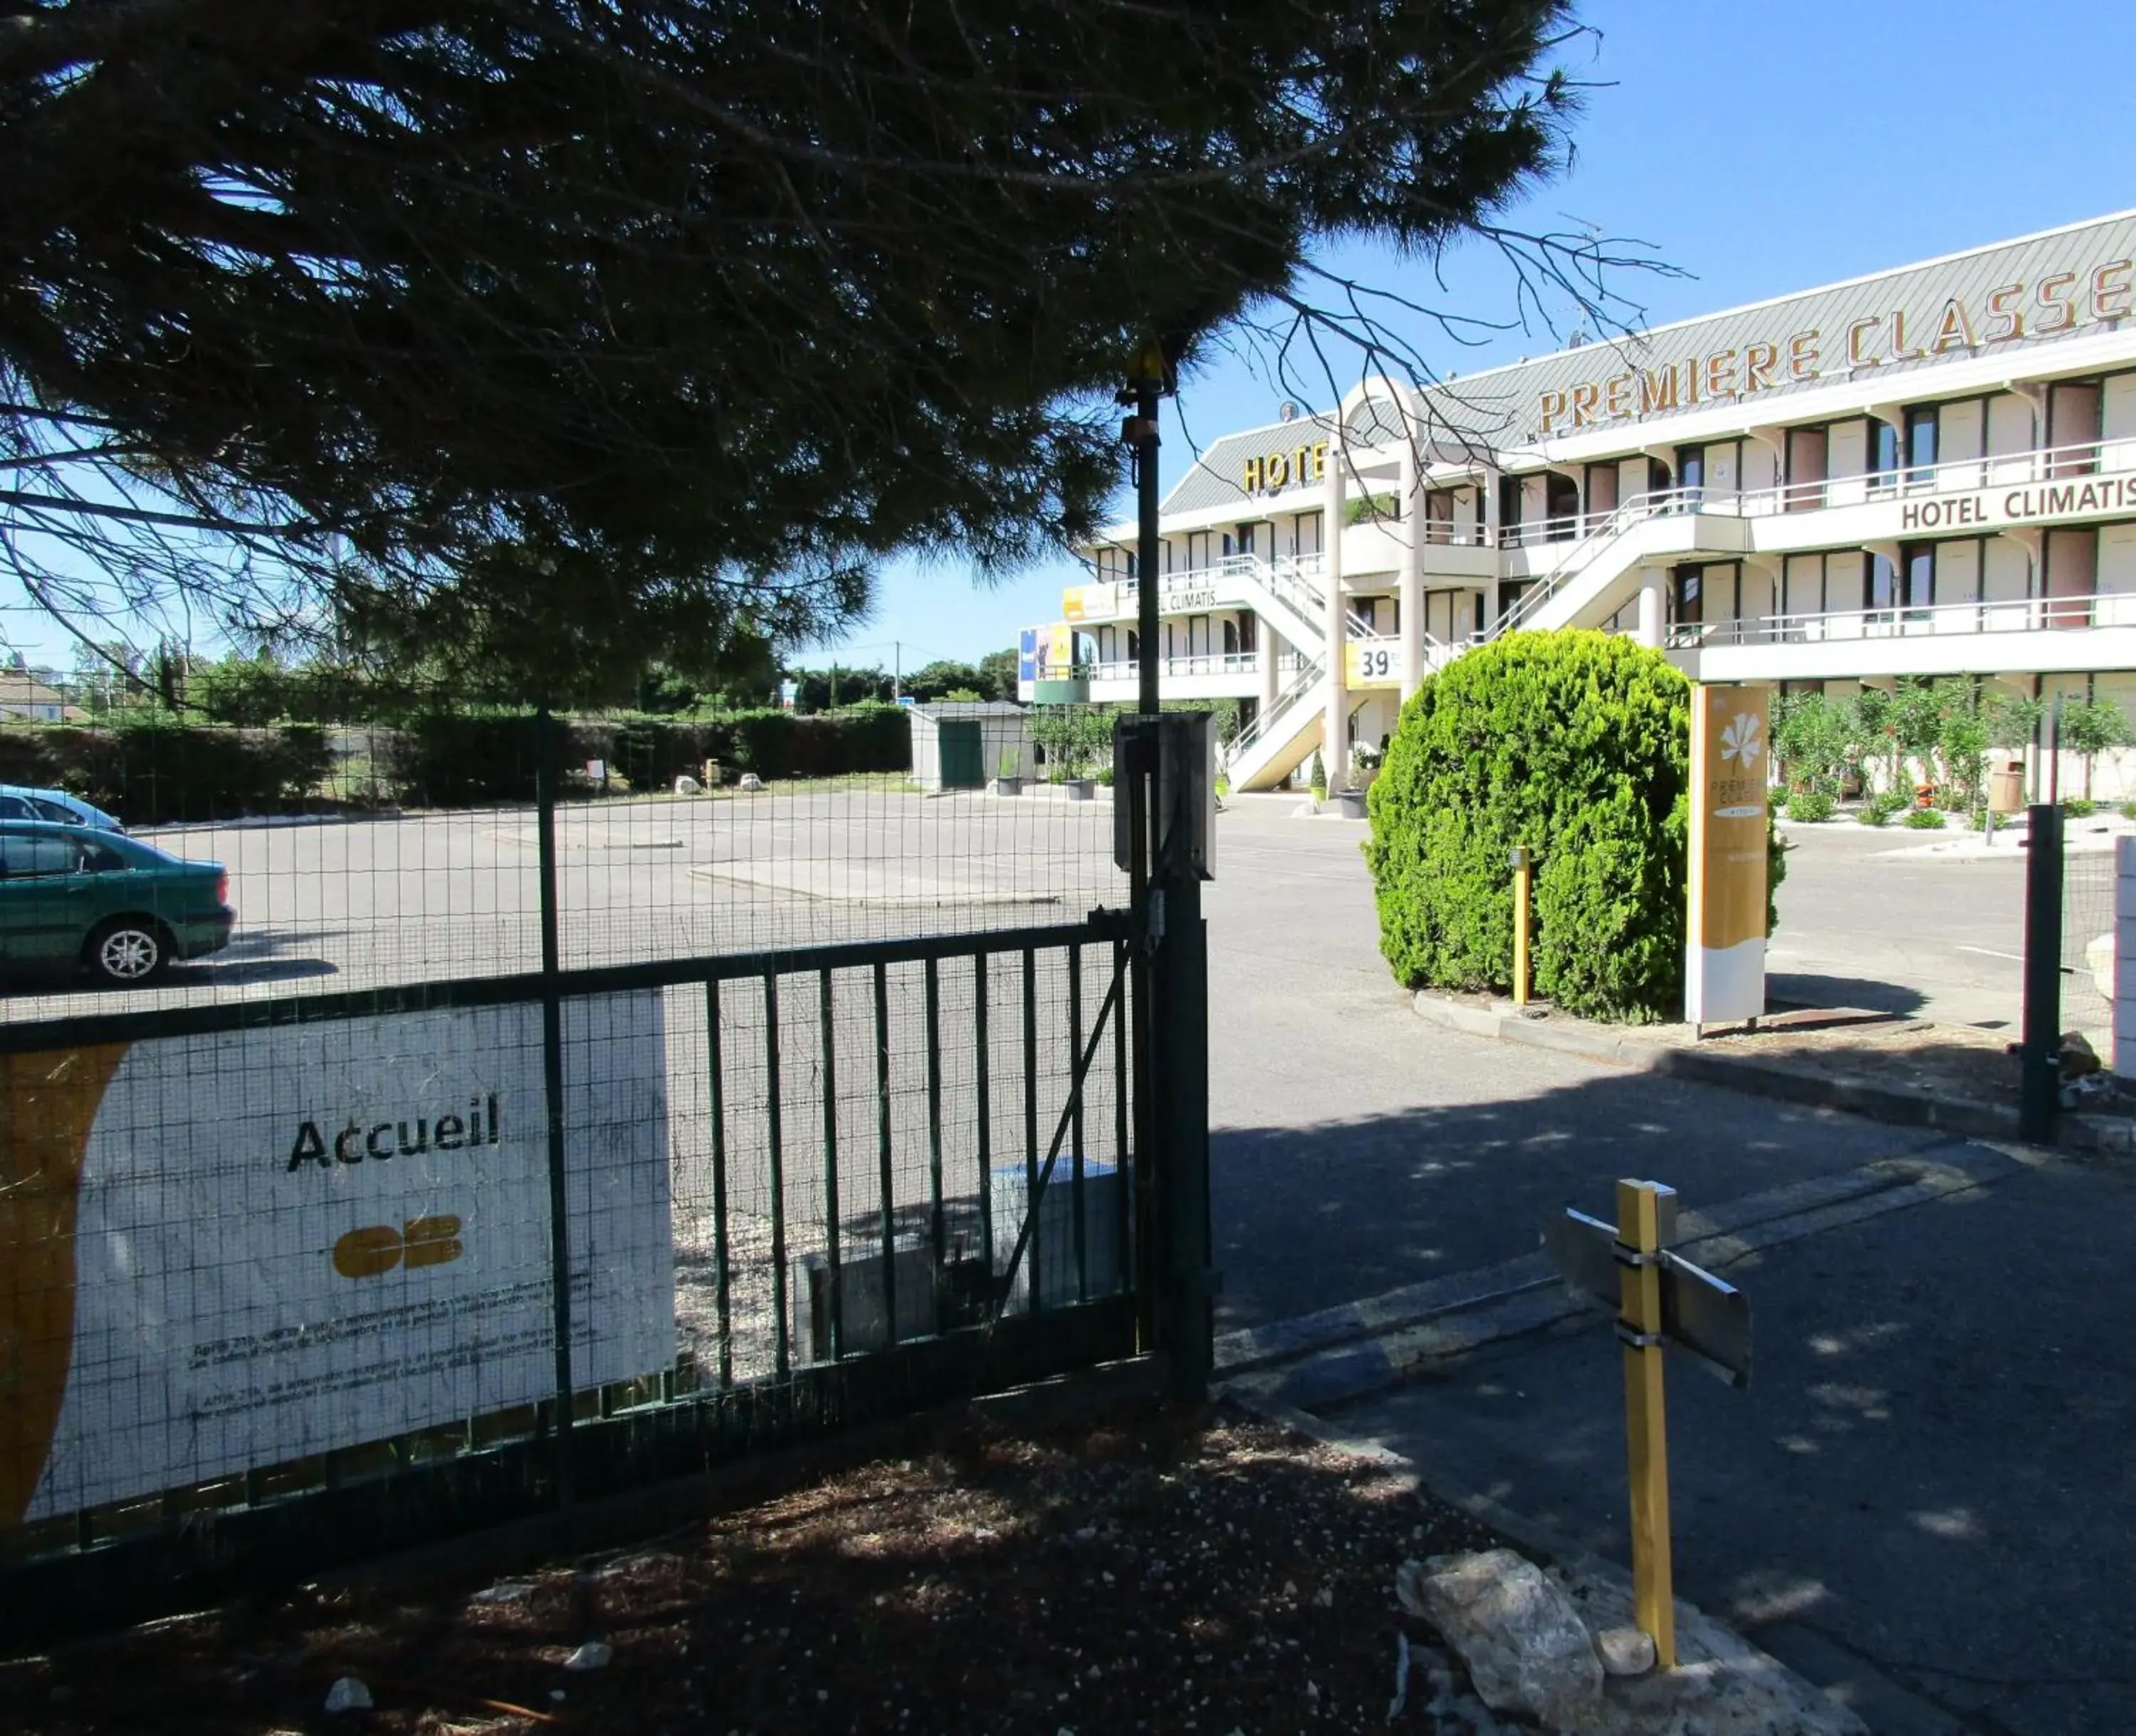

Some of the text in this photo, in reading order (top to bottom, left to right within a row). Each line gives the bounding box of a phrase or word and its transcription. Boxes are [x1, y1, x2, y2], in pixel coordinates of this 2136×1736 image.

[1539, 258, 2132, 432] PREMIERE CLASSE
[1245, 439, 1329, 493] HOTE
[1902, 496, 1988, 529] HOTEL
[1171, 590, 1215, 610] CLIMATIS
[1363, 650, 1388, 676] 39
[288, 1092, 499, 1172] Accueil
